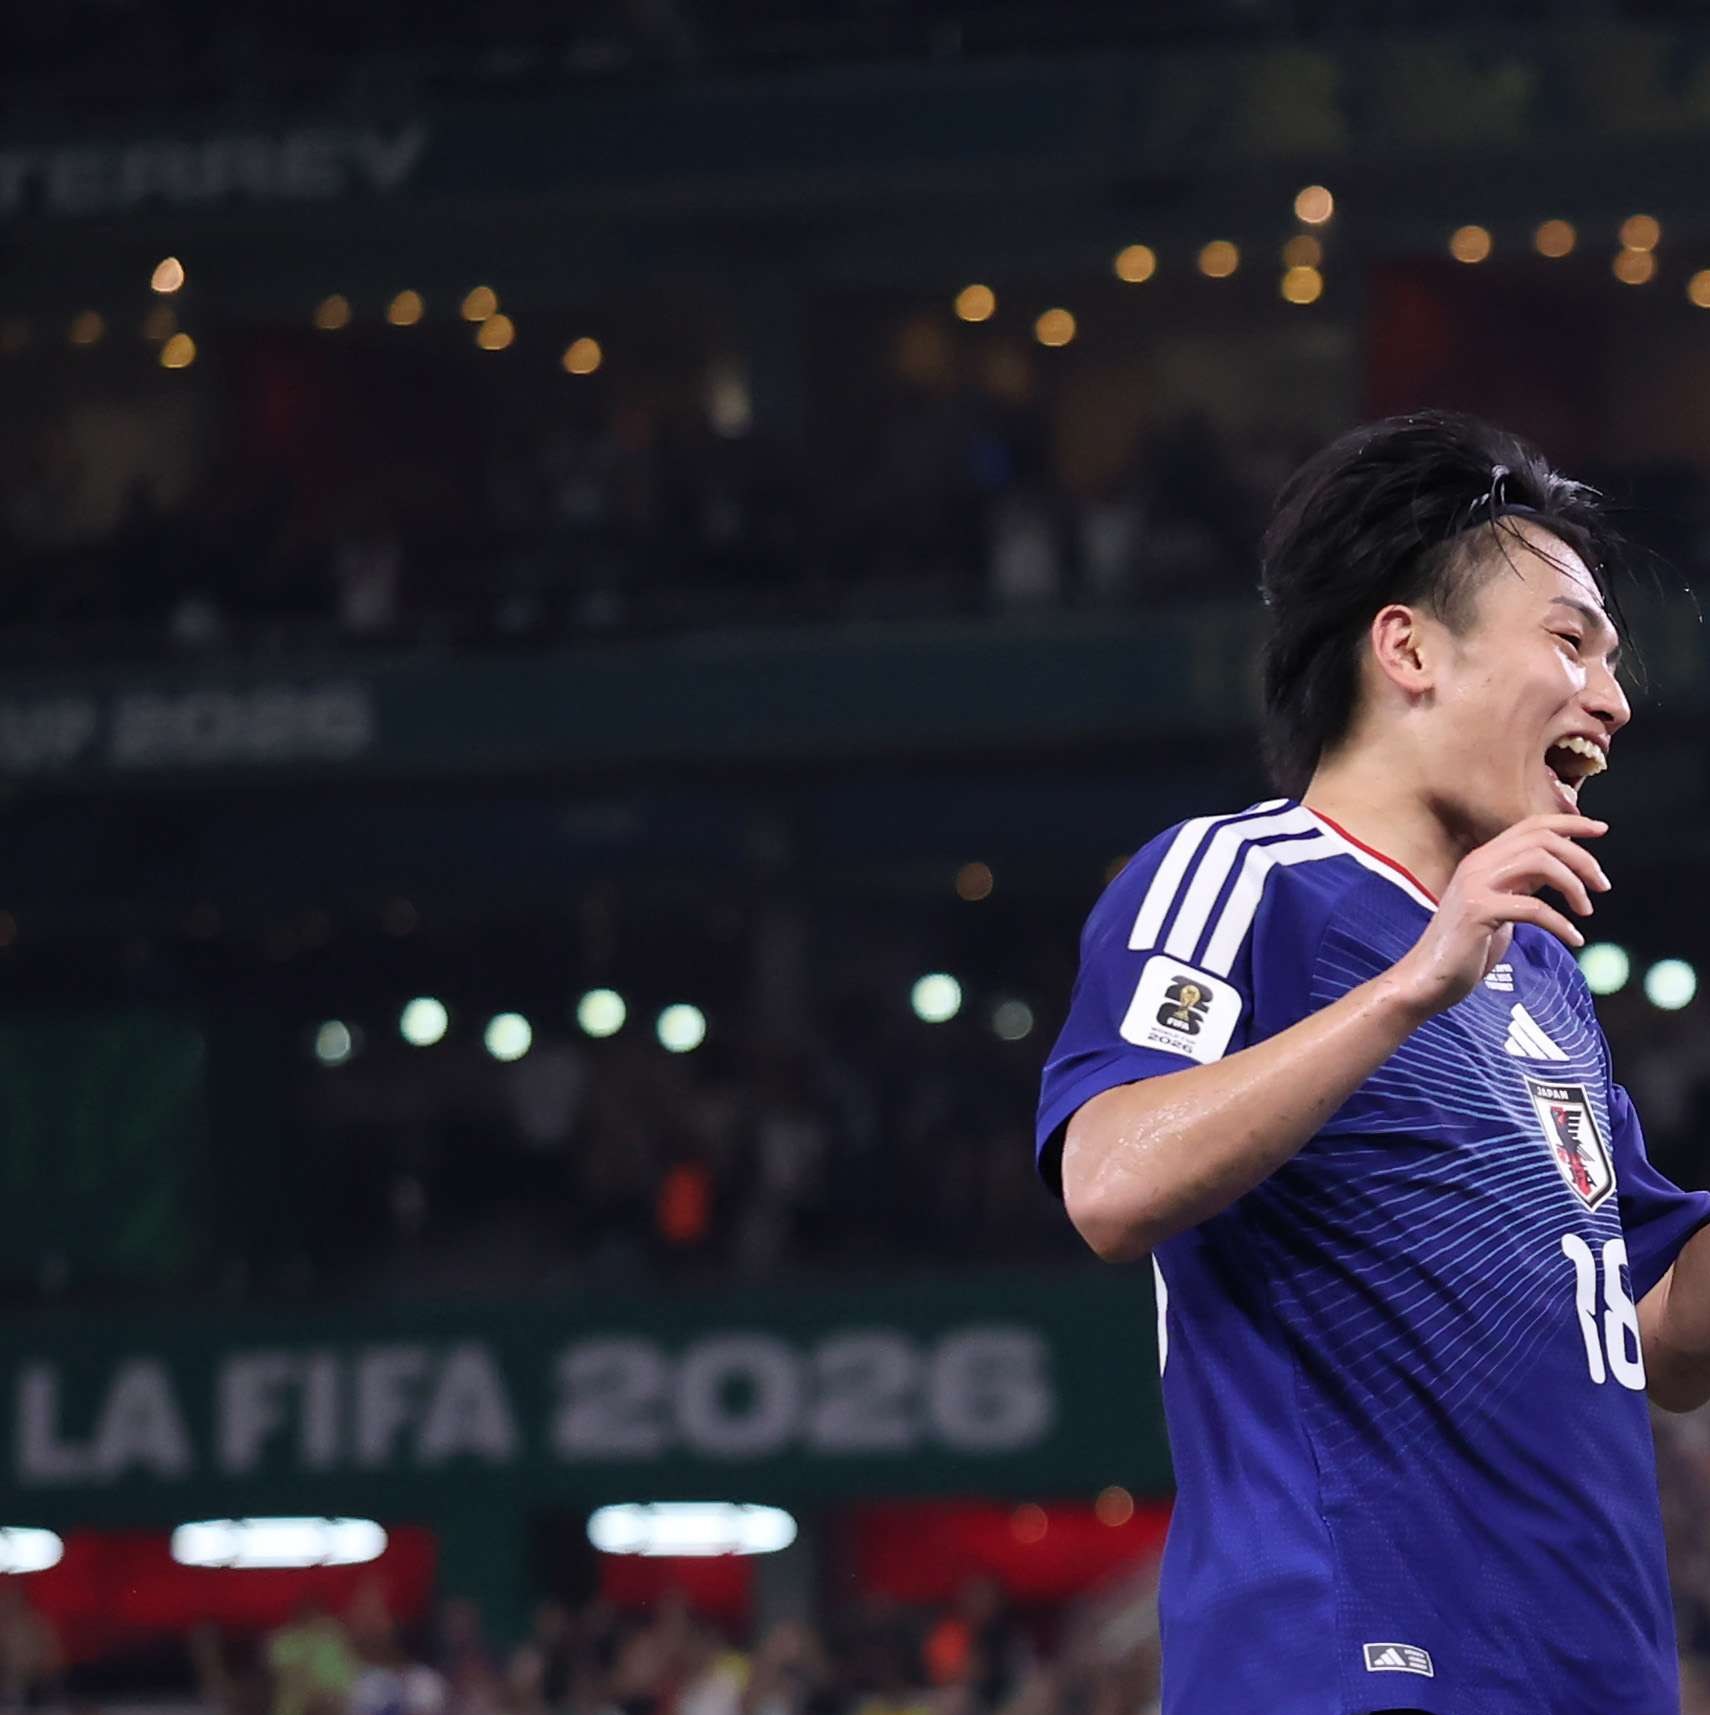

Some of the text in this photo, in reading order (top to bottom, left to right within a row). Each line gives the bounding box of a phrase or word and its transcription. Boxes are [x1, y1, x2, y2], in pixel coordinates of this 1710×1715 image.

[1148, 1032, 1193, 1054] 2026
[1536, 1086, 1569, 1100] JAPAN
[1561, 1233, 1646, 1391] 18
[18, 1326, 1054, 1484] LA FIFA 2026
